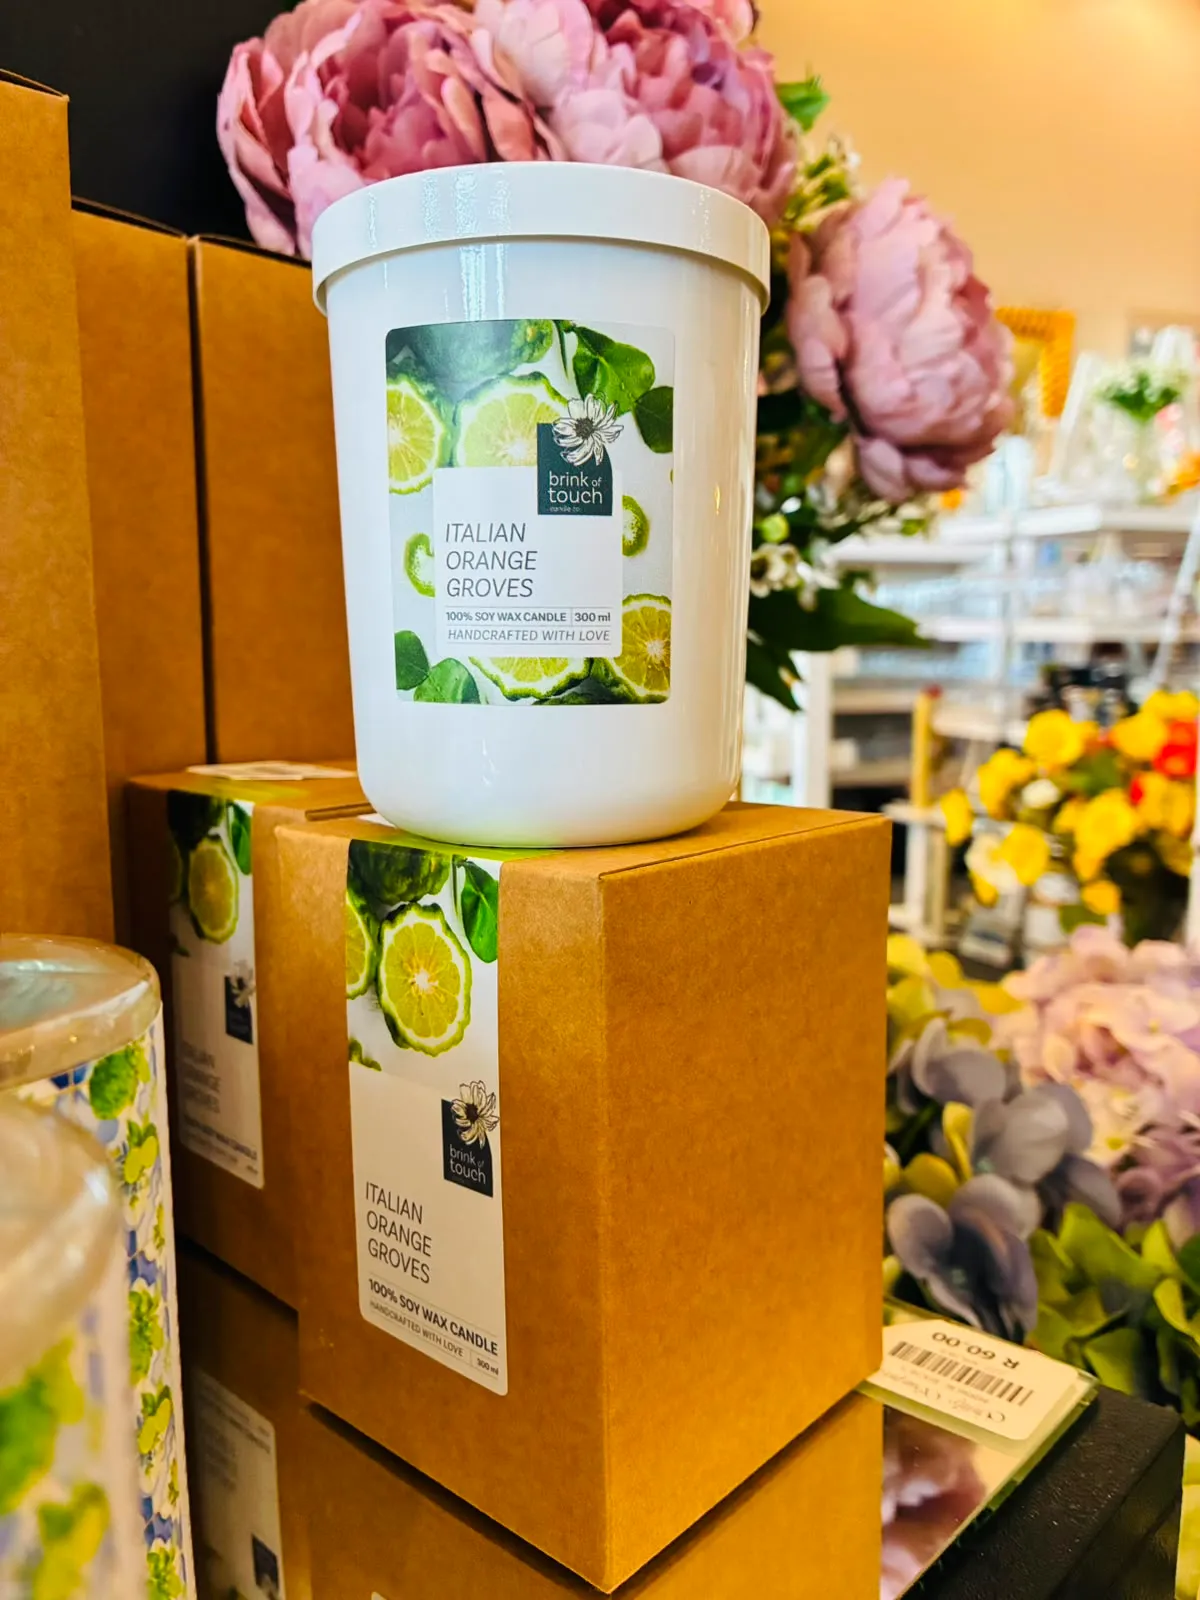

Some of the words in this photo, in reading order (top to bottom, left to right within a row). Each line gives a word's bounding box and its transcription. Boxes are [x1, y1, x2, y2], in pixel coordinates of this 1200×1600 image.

[549, 470, 589, 487] brink
[591, 476, 602, 487] of
[547, 487, 603, 504] touch
[446, 522, 526, 543] ITALIAN
[446, 550, 538, 570] ORANGE
[446, 578, 534, 597] GROVES
[446, 612, 473, 622] 100%
[475, 612, 495, 622] SOY
[497, 612, 522, 622] WAX
[523, 612, 567, 622] CANDLE
[574, 612, 596, 622] 300
[598, 612, 611, 622] ml
[448, 629, 539, 641] HANDCRAFTED
[542, 630, 575, 641] WITH
[578, 630, 610, 641] LOVE
[450, 1143, 476, 1166] brink
[449, 1158, 486, 1185] touch
[365, 1181, 423, 1225] ITALIAN
[366, 1210, 432, 1257] ORANGE
[367, 1237, 430, 1284] GROVES
[368, 1278, 398, 1304] 100%
[399, 1294, 420, 1316] SOY
[421, 1305, 448, 1332] WAX
[449, 1321, 498, 1357] CANDLE
[369, 1300, 421, 1334] HANDCRAFTED
[421, 1328, 442, 1345] WITH
[443, 1339, 464, 1357] LOVE
[932, 1332, 996, 1360] 60.00
[476, 1358, 490, 1372] 300
[1003, 1357, 1020, 1369] R
